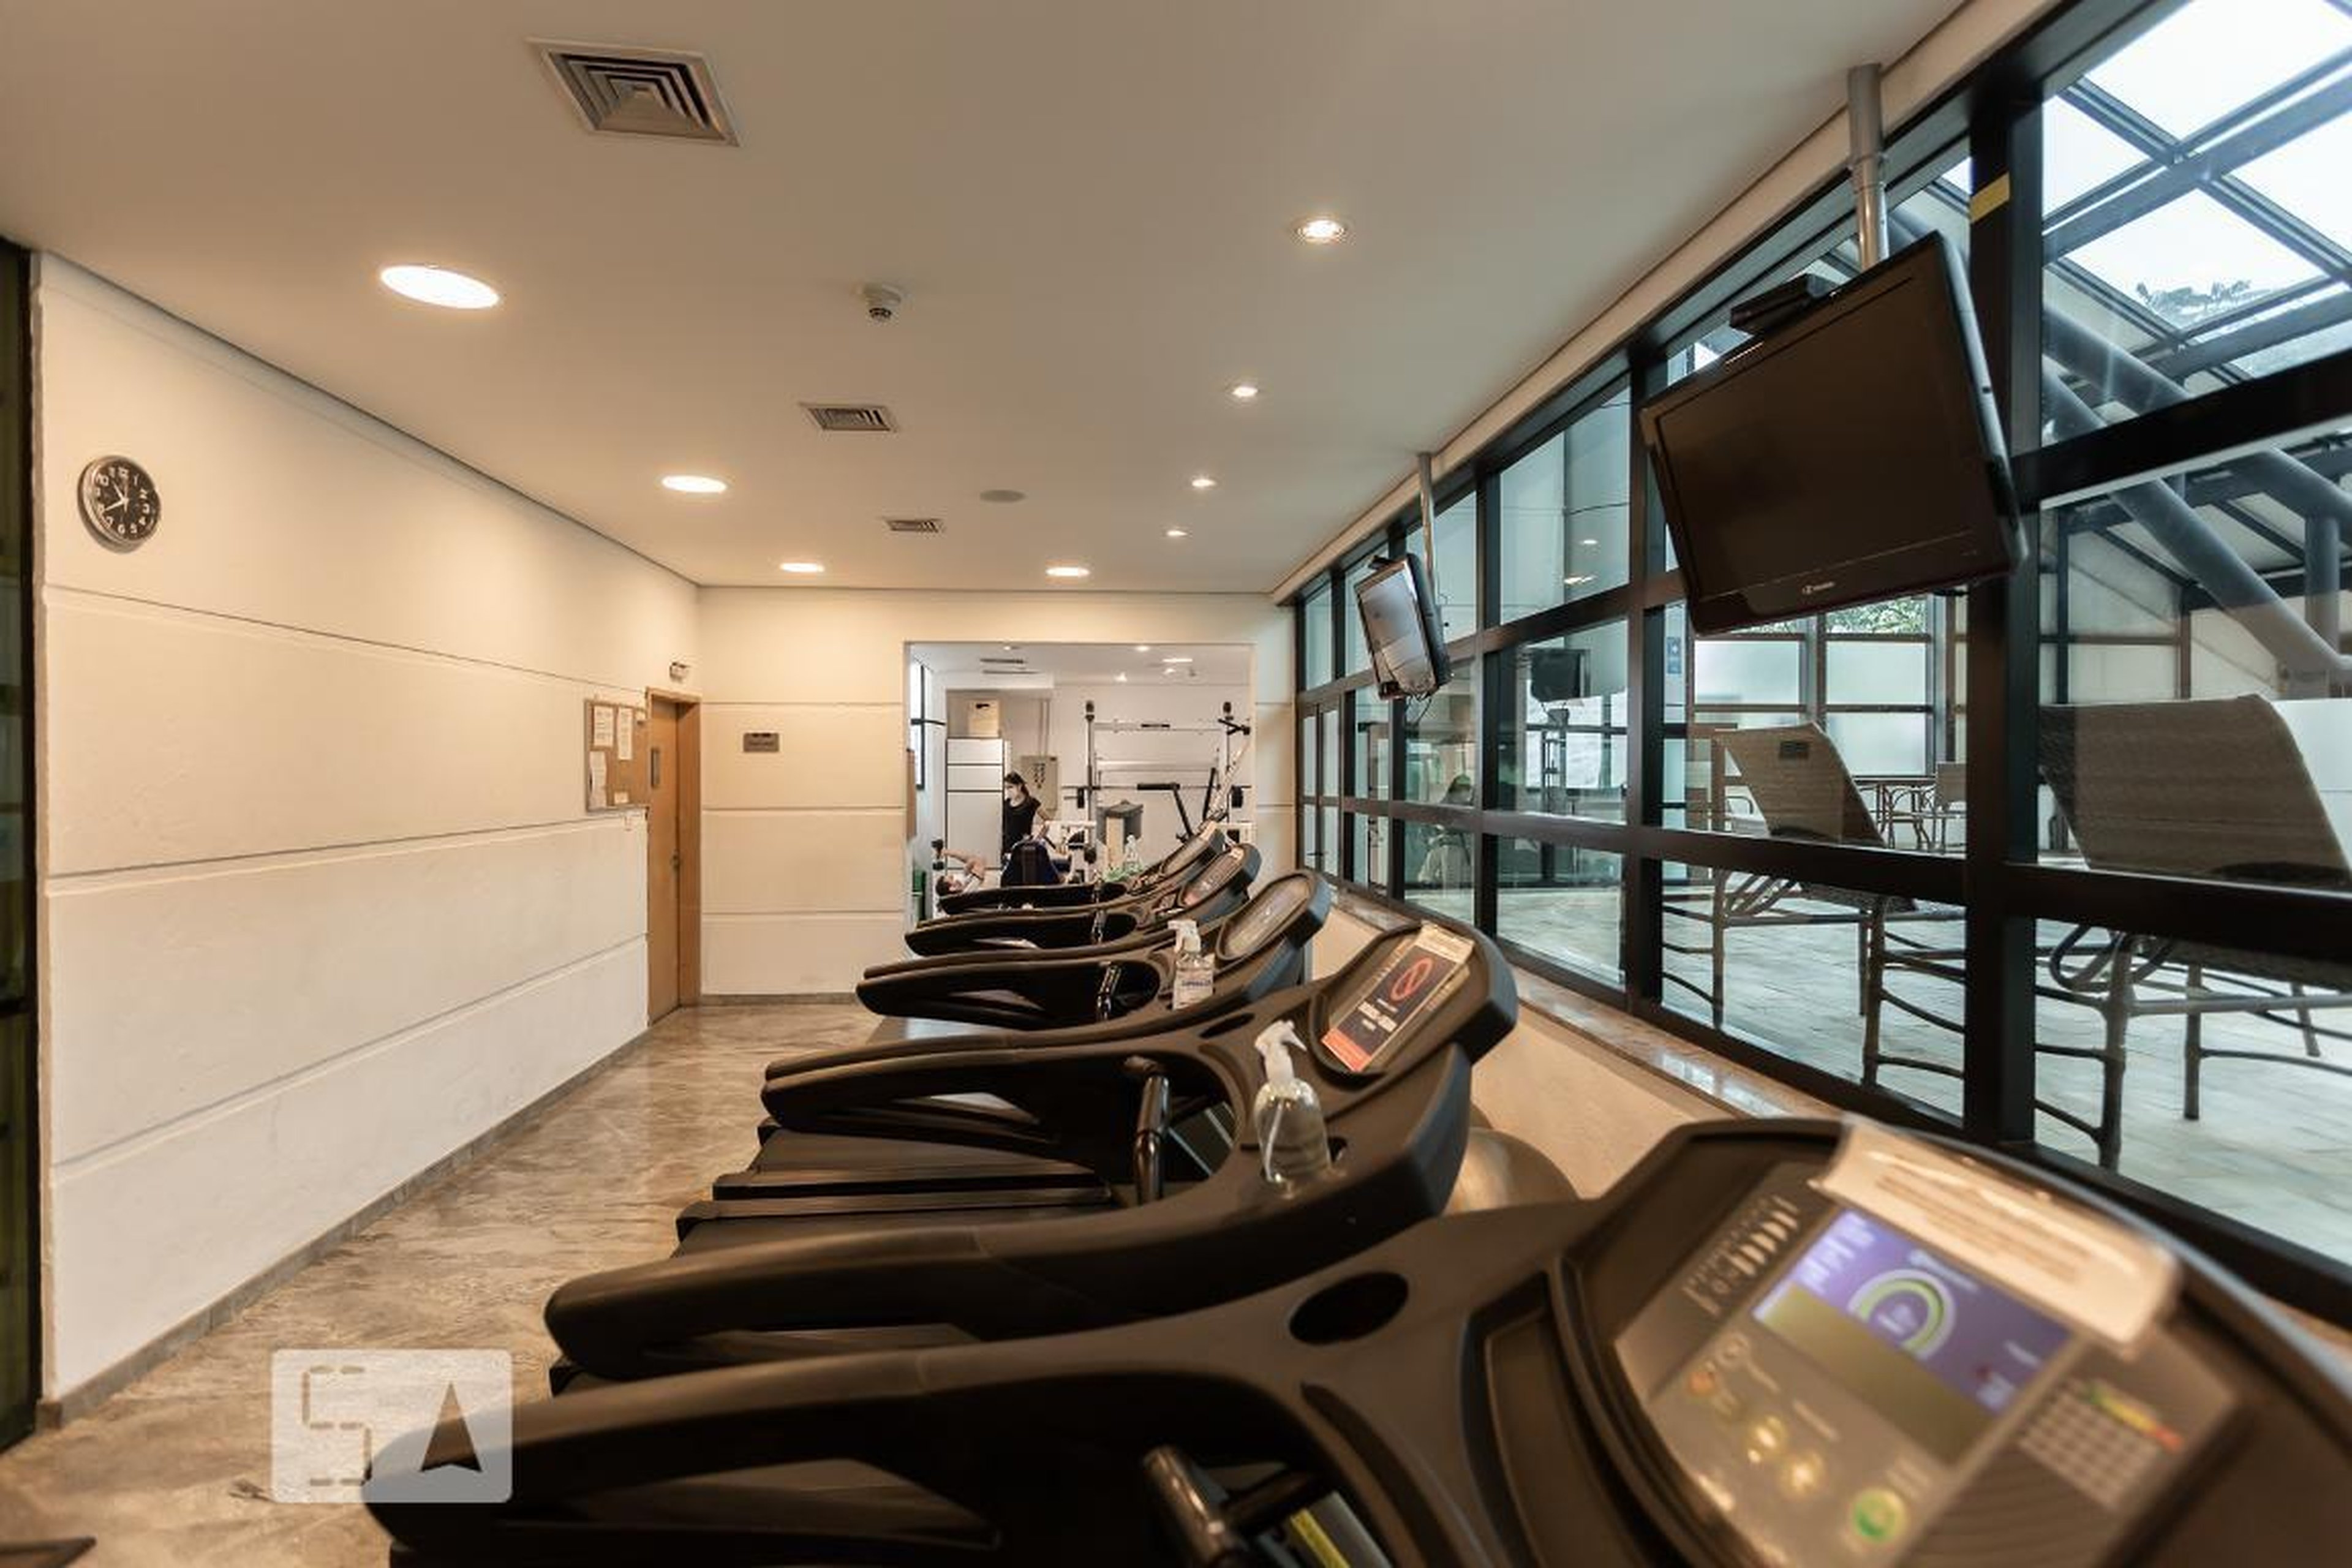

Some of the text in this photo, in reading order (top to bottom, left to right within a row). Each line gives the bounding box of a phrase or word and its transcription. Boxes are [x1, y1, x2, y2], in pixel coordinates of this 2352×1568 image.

[140, 488, 149, 499] 2
[143, 504, 150, 514] 3
[138, 516, 146, 526] 4
[118, 524, 126, 535] 6
[130, 524, 138, 533] 5
